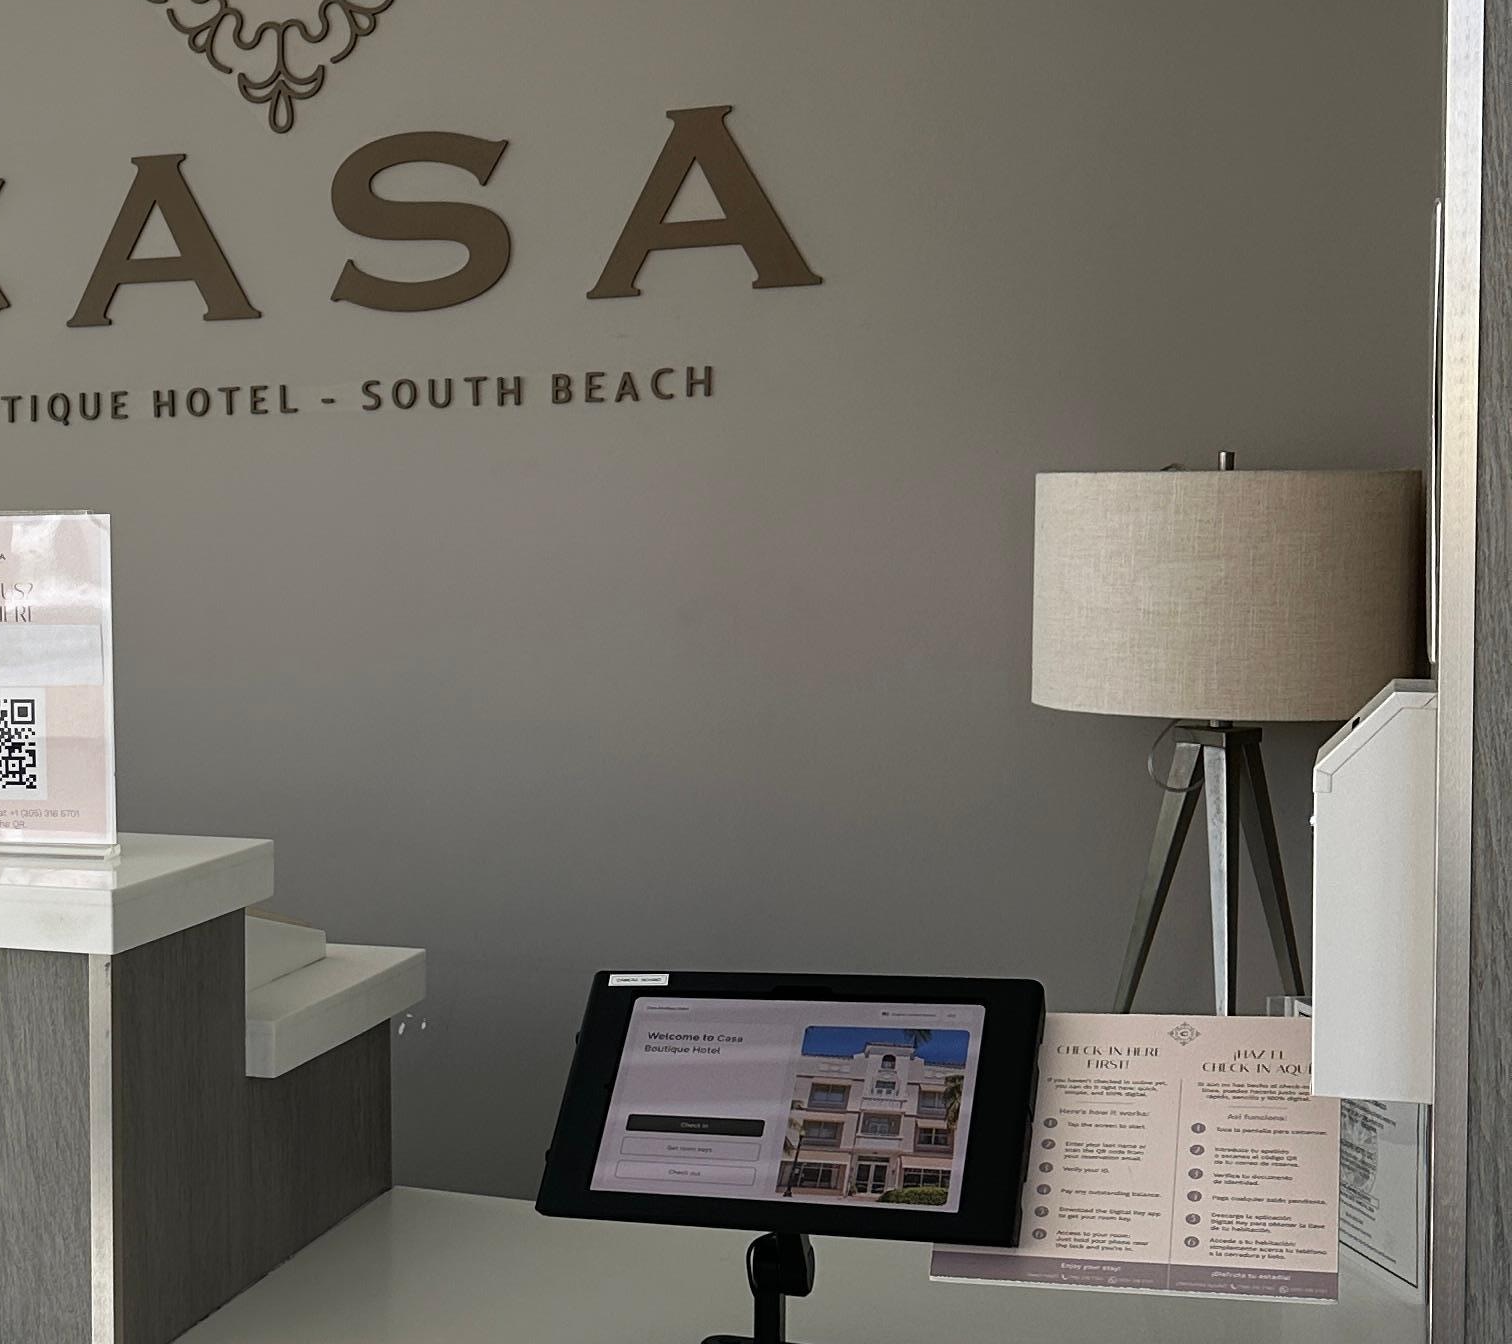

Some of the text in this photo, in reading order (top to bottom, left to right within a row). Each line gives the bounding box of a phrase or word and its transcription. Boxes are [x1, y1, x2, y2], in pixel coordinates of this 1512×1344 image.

[152, 384, 299, 419] HOTEL
[362, 375, 522, 411] SOUTH
[551, 365, 713, 405] BEACH
[1, 583, 33, 600] US?
[648, 1032, 743, 1043] Welcome to Casa
[644, 1045, 720, 1054] Boutique Hotel
[1127, 1047, 1159, 1057] HERE
